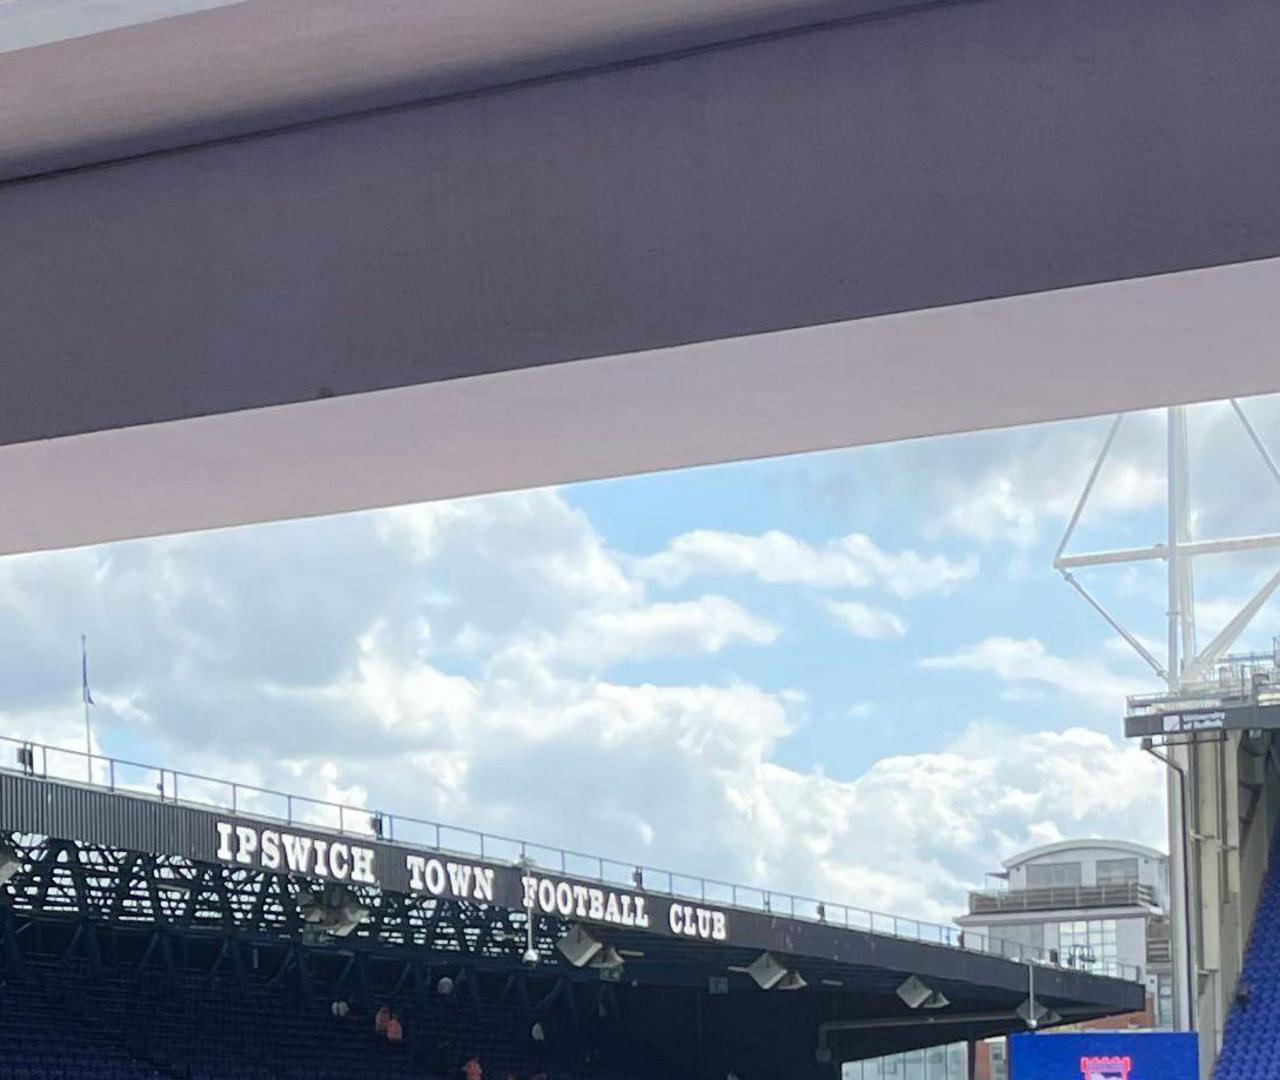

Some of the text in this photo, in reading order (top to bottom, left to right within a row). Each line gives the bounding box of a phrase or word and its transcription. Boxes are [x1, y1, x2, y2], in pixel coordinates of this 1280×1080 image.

[216, 821, 727, 940] IPSWICH TOWN FOOTBALL CLUB
